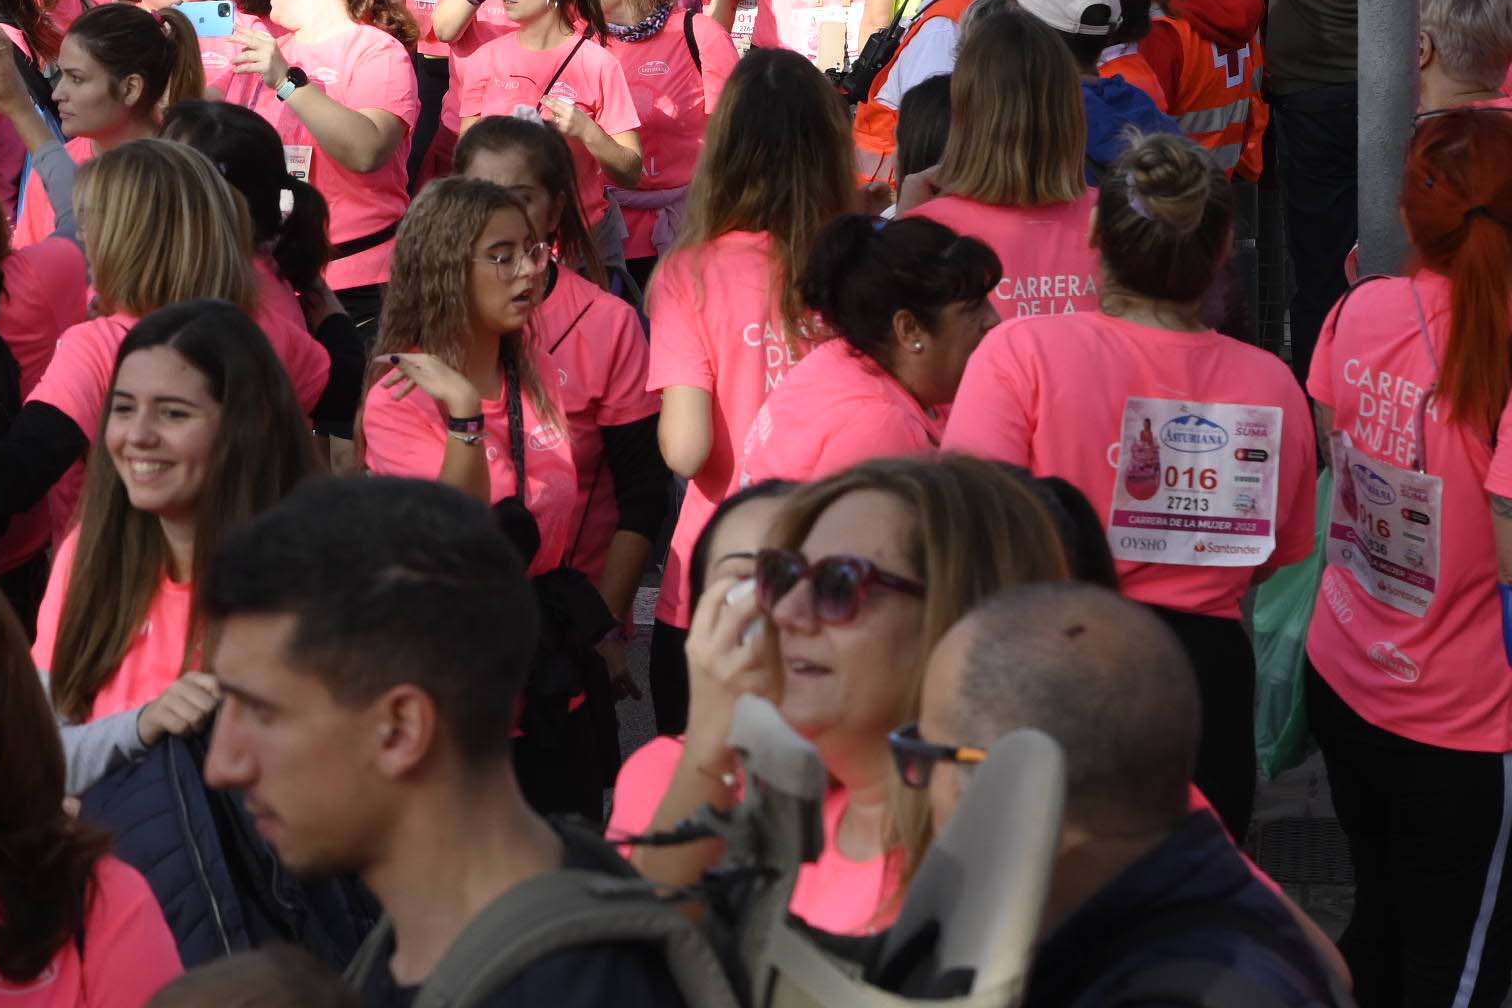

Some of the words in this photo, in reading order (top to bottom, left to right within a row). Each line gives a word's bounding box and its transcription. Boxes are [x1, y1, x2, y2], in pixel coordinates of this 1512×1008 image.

[995, 274, 1096, 300] CARRERA
[1017, 300, 1040, 319] DE
[1359, 393, 1392, 425] DE
[1164, 428, 1222, 445] ASTURIANA
[1236, 427, 1268, 438] SUMA
[1164, 466, 1218, 490] 016
[1167, 496, 1209, 512] 27213
[1129, 515, 1167, 526] CARRERA
[1169, 517, 1181, 527] DE
[1184, 518, 1196, 528] LA
[1198, 519, 1232, 530] MUJER
[1234, 521, 1256, 532] 2023
[1121, 536, 1167, 552] OYSHO
[1207, 541, 1261, 555] Santander
